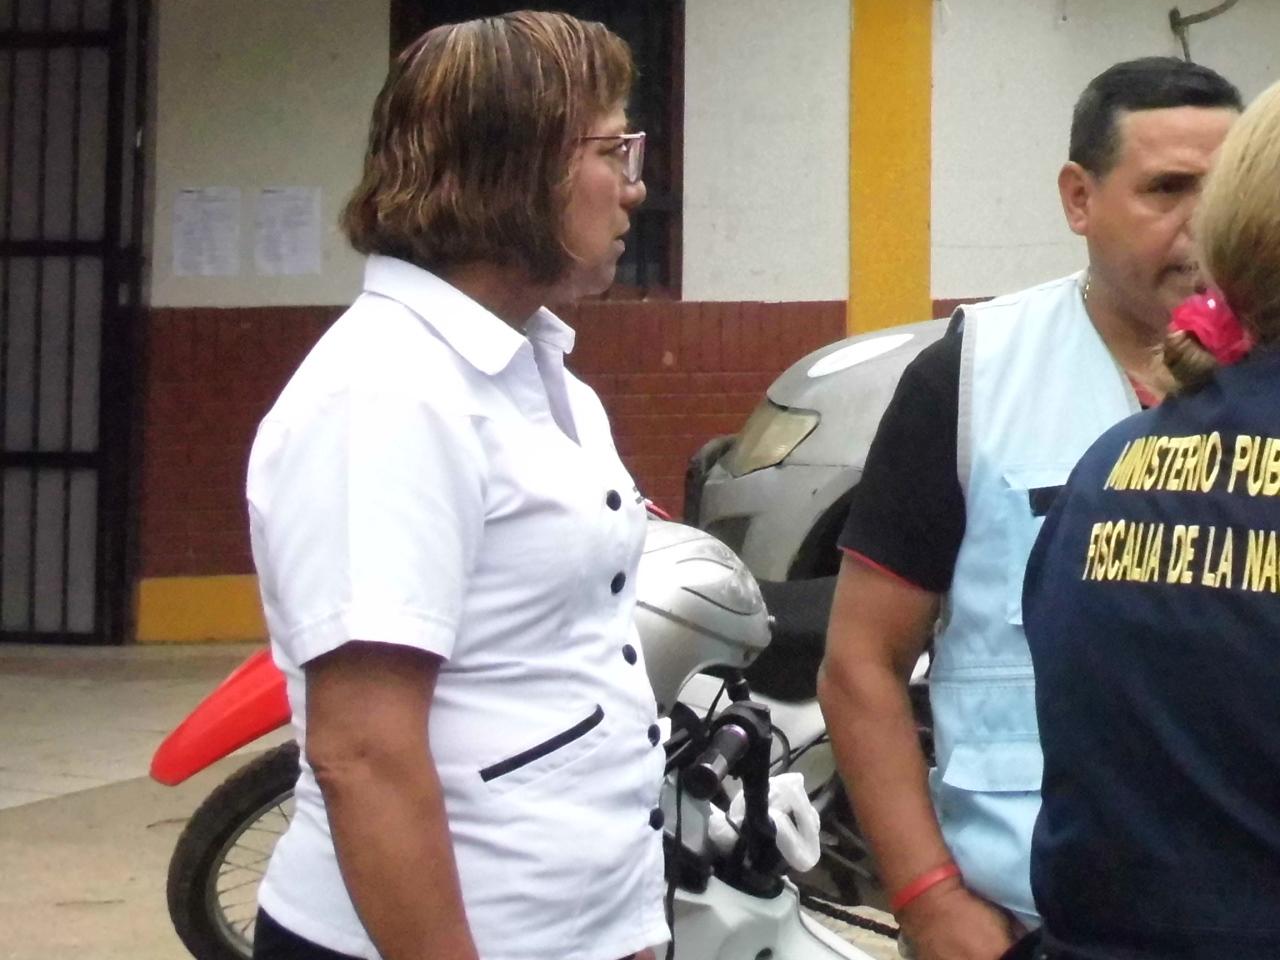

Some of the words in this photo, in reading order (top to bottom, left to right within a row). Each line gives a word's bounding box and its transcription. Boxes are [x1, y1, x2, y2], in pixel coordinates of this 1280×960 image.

[1103, 431, 1223, 494] MINISTERIO
[1083, 519, 1165, 583] FISCALIA
[1166, 524, 1200, 585] DE
[1201, 526, 1234, 589] LA
